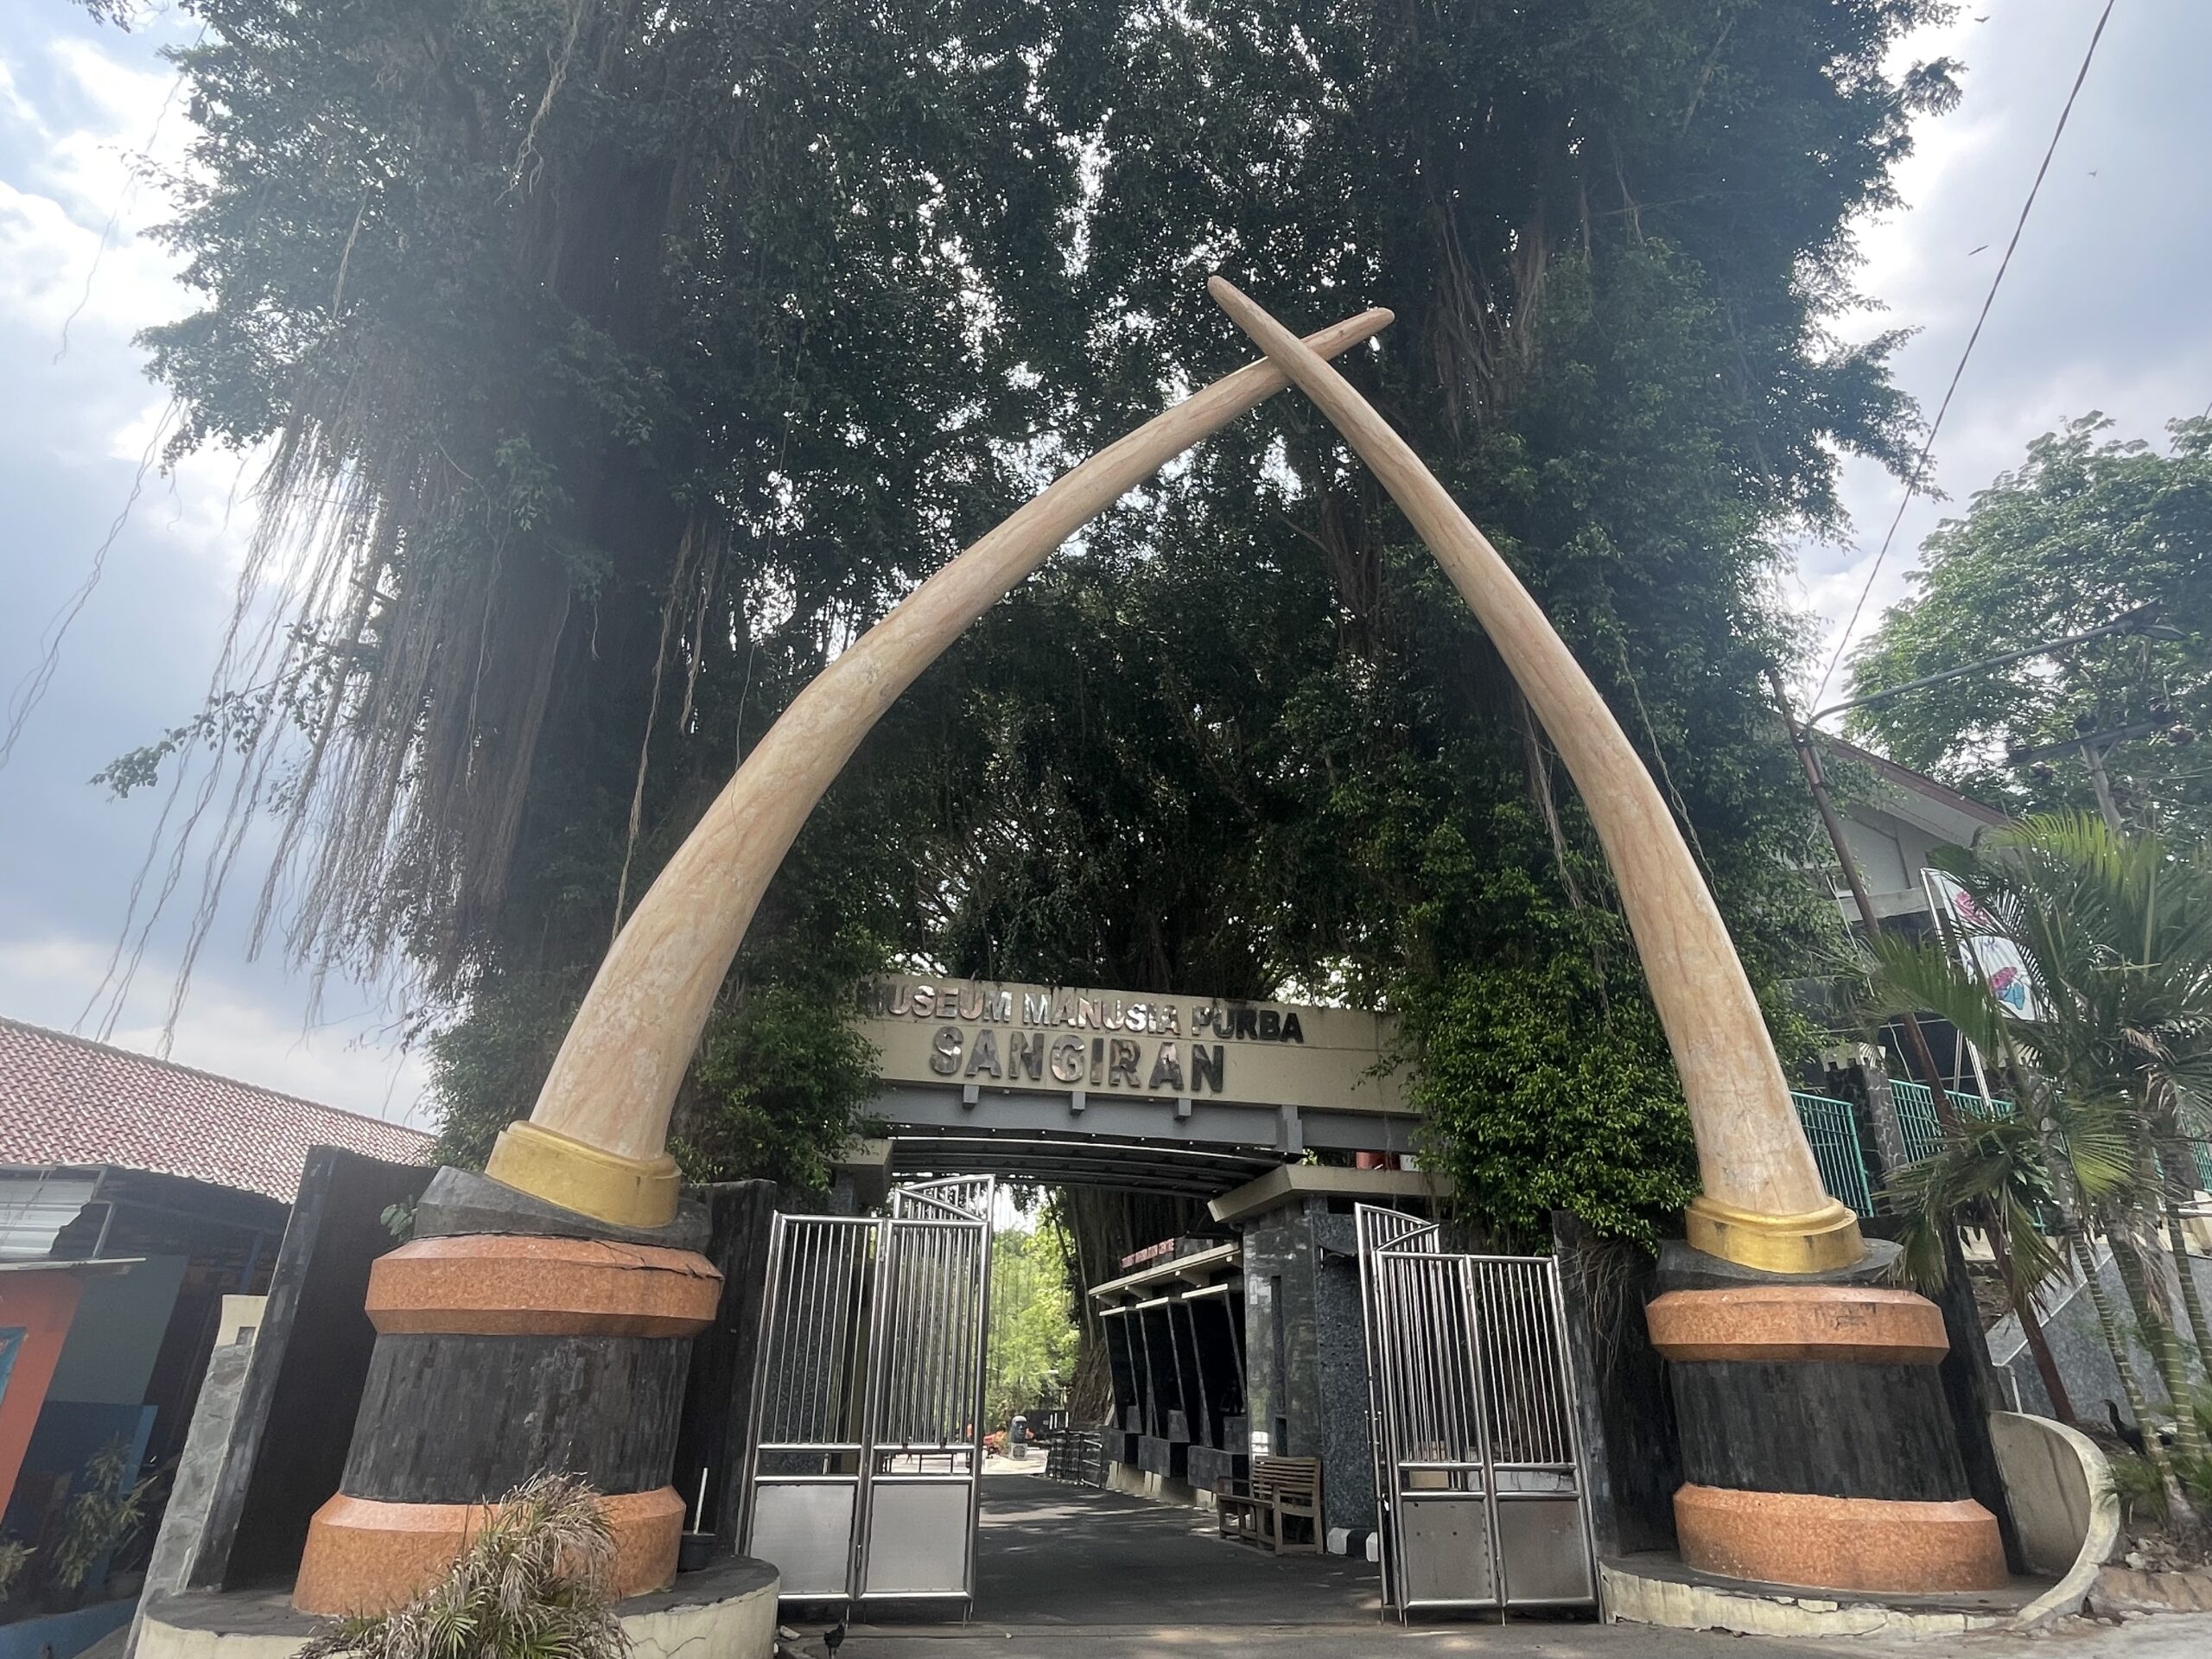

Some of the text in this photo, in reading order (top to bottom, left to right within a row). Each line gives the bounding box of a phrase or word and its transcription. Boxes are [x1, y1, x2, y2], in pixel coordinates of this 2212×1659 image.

[1023, 992, 1181, 1035] MANUSIA
[1192, 1005, 1304, 1043] PURBA
[931, 1026, 1224, 1092] SANGIRAN
